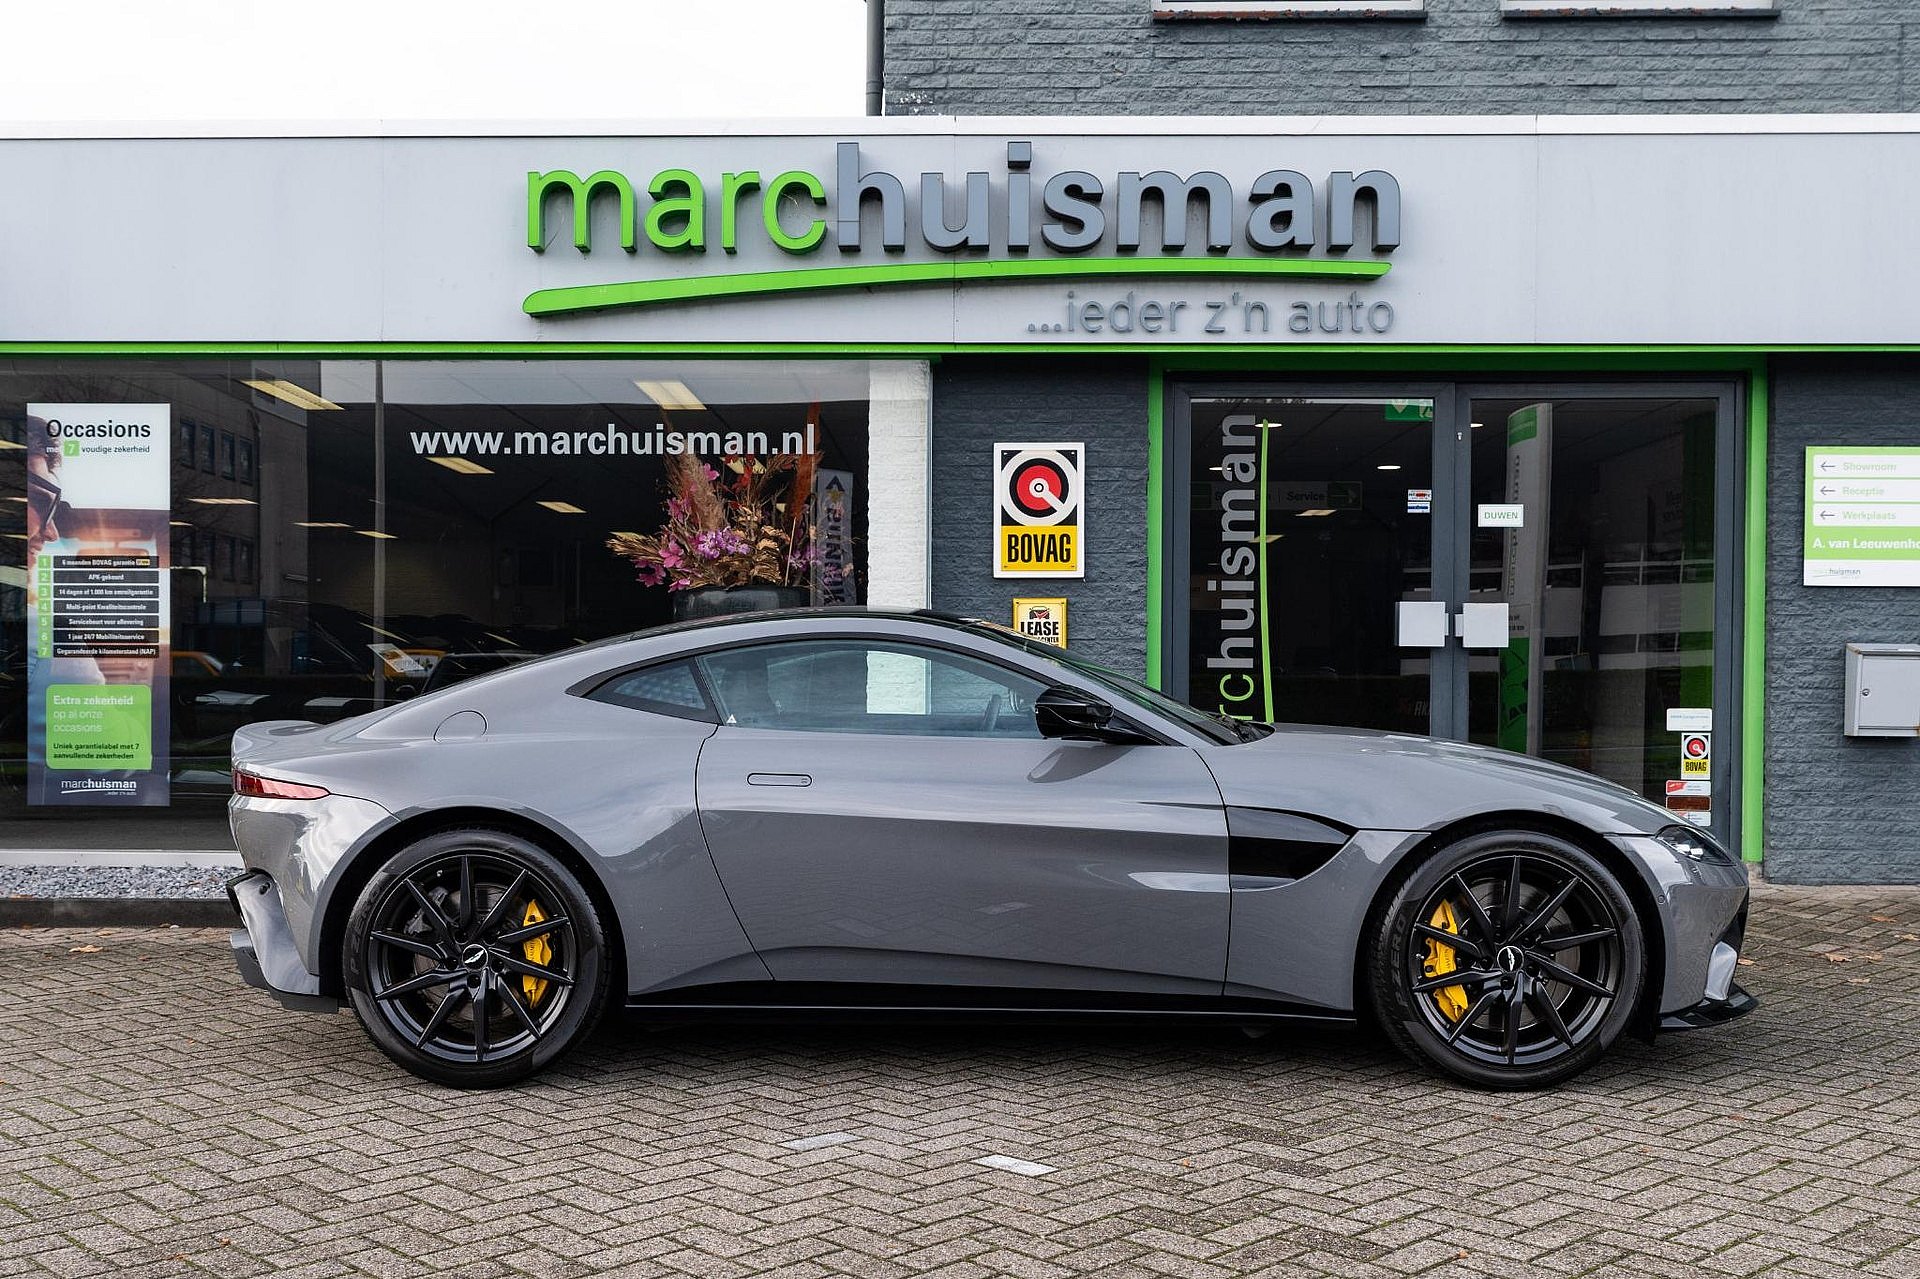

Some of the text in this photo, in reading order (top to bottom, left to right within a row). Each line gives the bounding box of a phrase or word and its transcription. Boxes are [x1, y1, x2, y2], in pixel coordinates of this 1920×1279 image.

[527, 141, 1401, 253] marchuisman
[1204, 291, 1269, 333] z'n
[1288, 291, 1395, 333] auto
[46, 419, 151, 438] Occasions
[410, 424, 815, 455] www.marchuisman.nl
[81, 445, 112, 454] voudige
[114, 445, 150, 453] zekerheid
[1843, 462, 1897, 471] Showroom
[1842, 486, 1885, 497] Receptie
[1484, 511, 1518, 520] DUWEN
[1842, 511, 1897, 521] Werkplaats
[1007, 533, 1071, 563] BOVAG
[1813, 538, 1826, 548] A.
[1829, 540, 1849, 548] van
[1206, 414, 1256, 720] rchuisman
[53, 695, 134, 705] Extra zekerheid
[53, 711, 66, 720] op
[79, 711, 103, 719] onze
[53, 723, 102, 732] occasions
[74, 743, 119, 751] garantielabel
[1685, 761, 1707, 772] BOVAG
[61, 778, 137, 789] marchuisman
